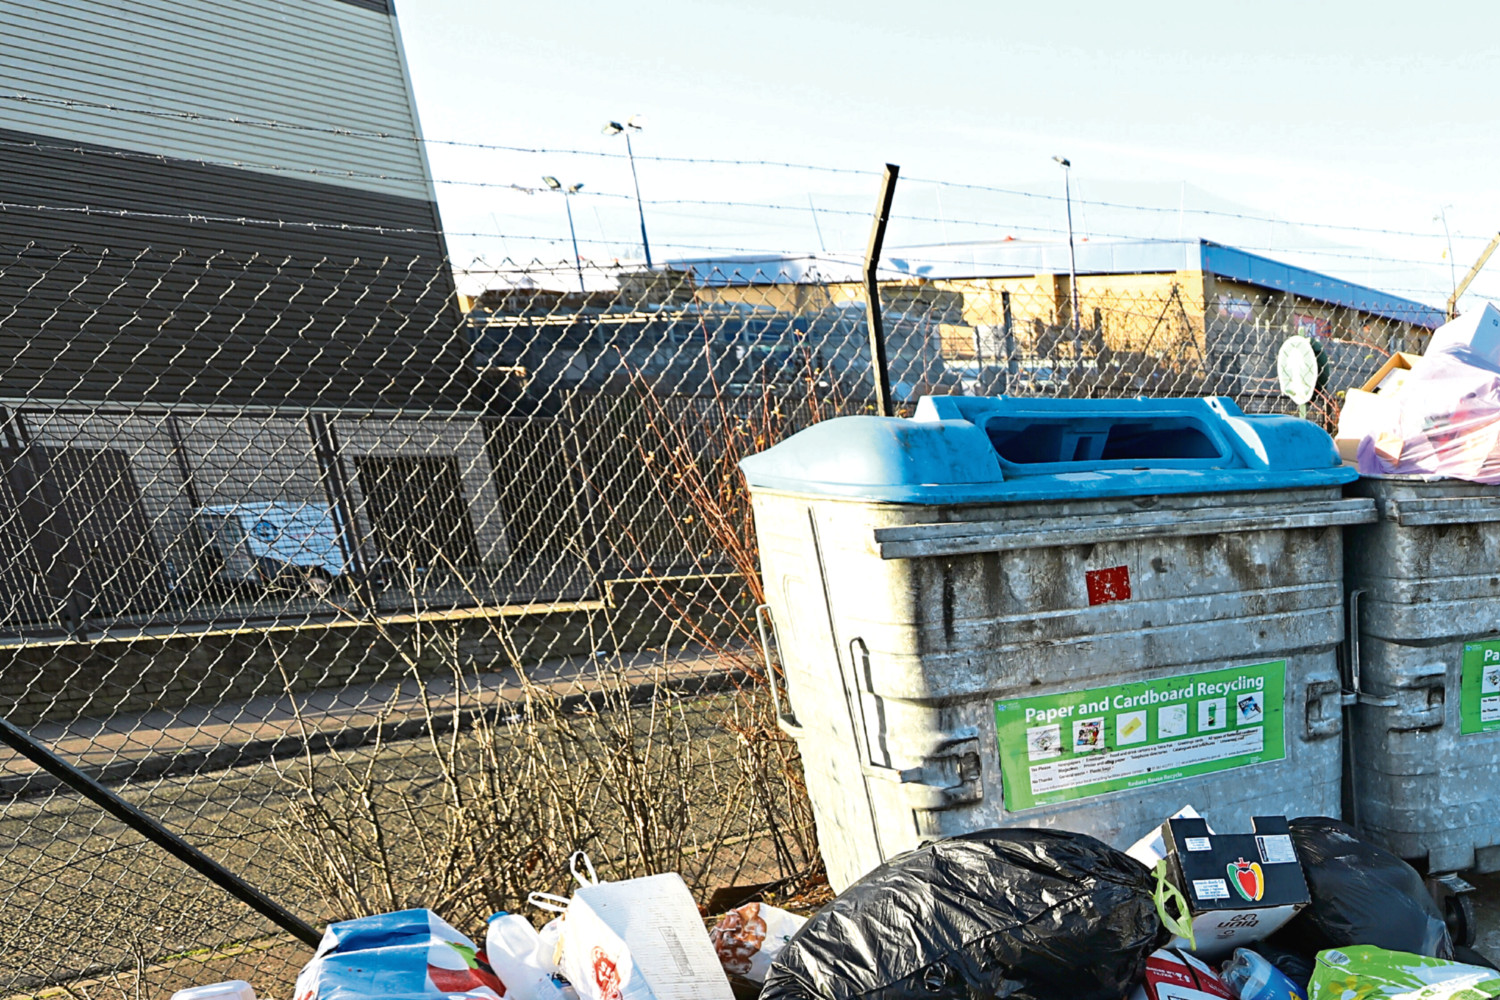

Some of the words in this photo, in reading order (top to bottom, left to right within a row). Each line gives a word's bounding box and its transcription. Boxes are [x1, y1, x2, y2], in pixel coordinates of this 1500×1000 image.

[1025, 704, 1076, 723] Paper
[1078, 696, 1110, 714] and
[1113, 684, 1195, 709] Cardboard
[1198, 676, 1265, 697] Recycling
